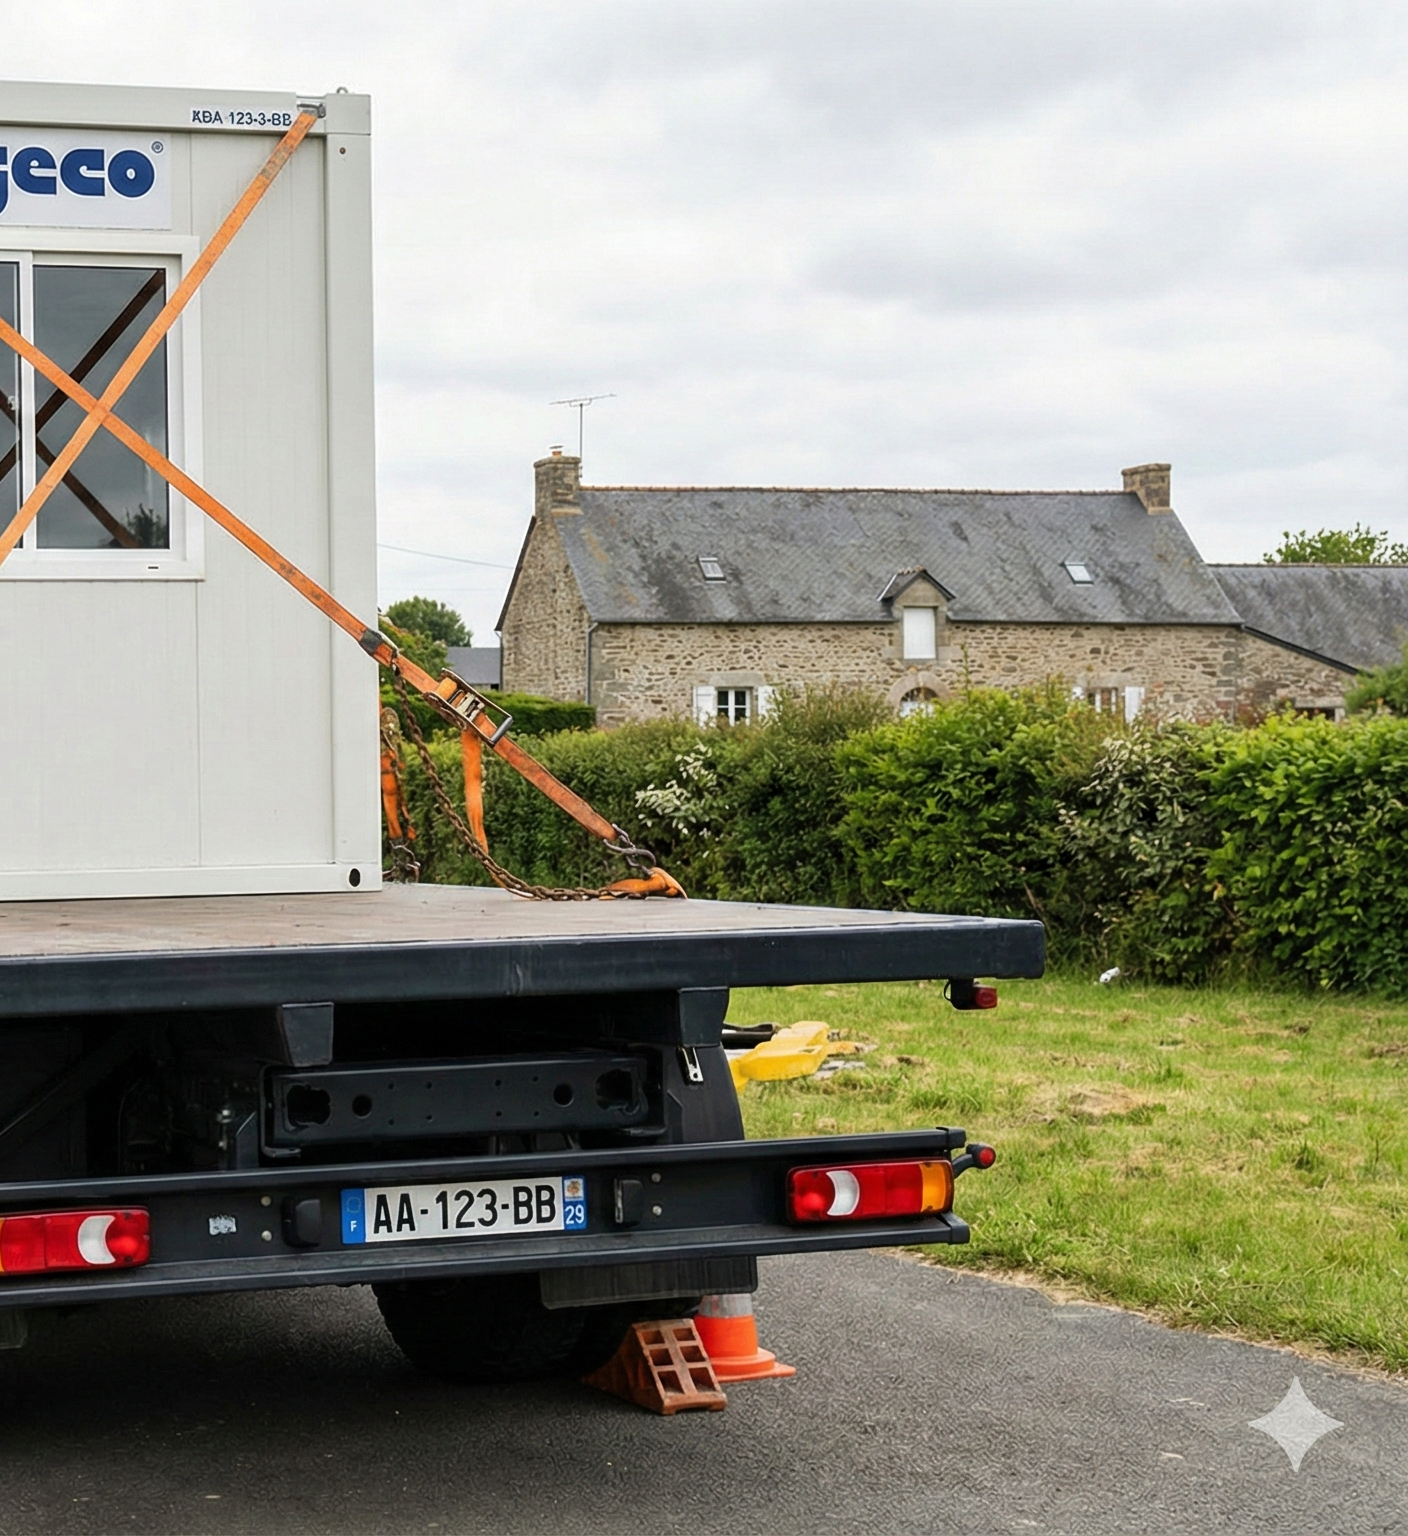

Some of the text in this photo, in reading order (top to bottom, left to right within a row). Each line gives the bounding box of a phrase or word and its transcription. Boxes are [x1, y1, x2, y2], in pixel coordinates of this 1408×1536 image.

[373, 1184, 556, 1234] AA-123-BB
[565, 1205, 585, 1225] 29
[350, 1221, 358, 1233] F
